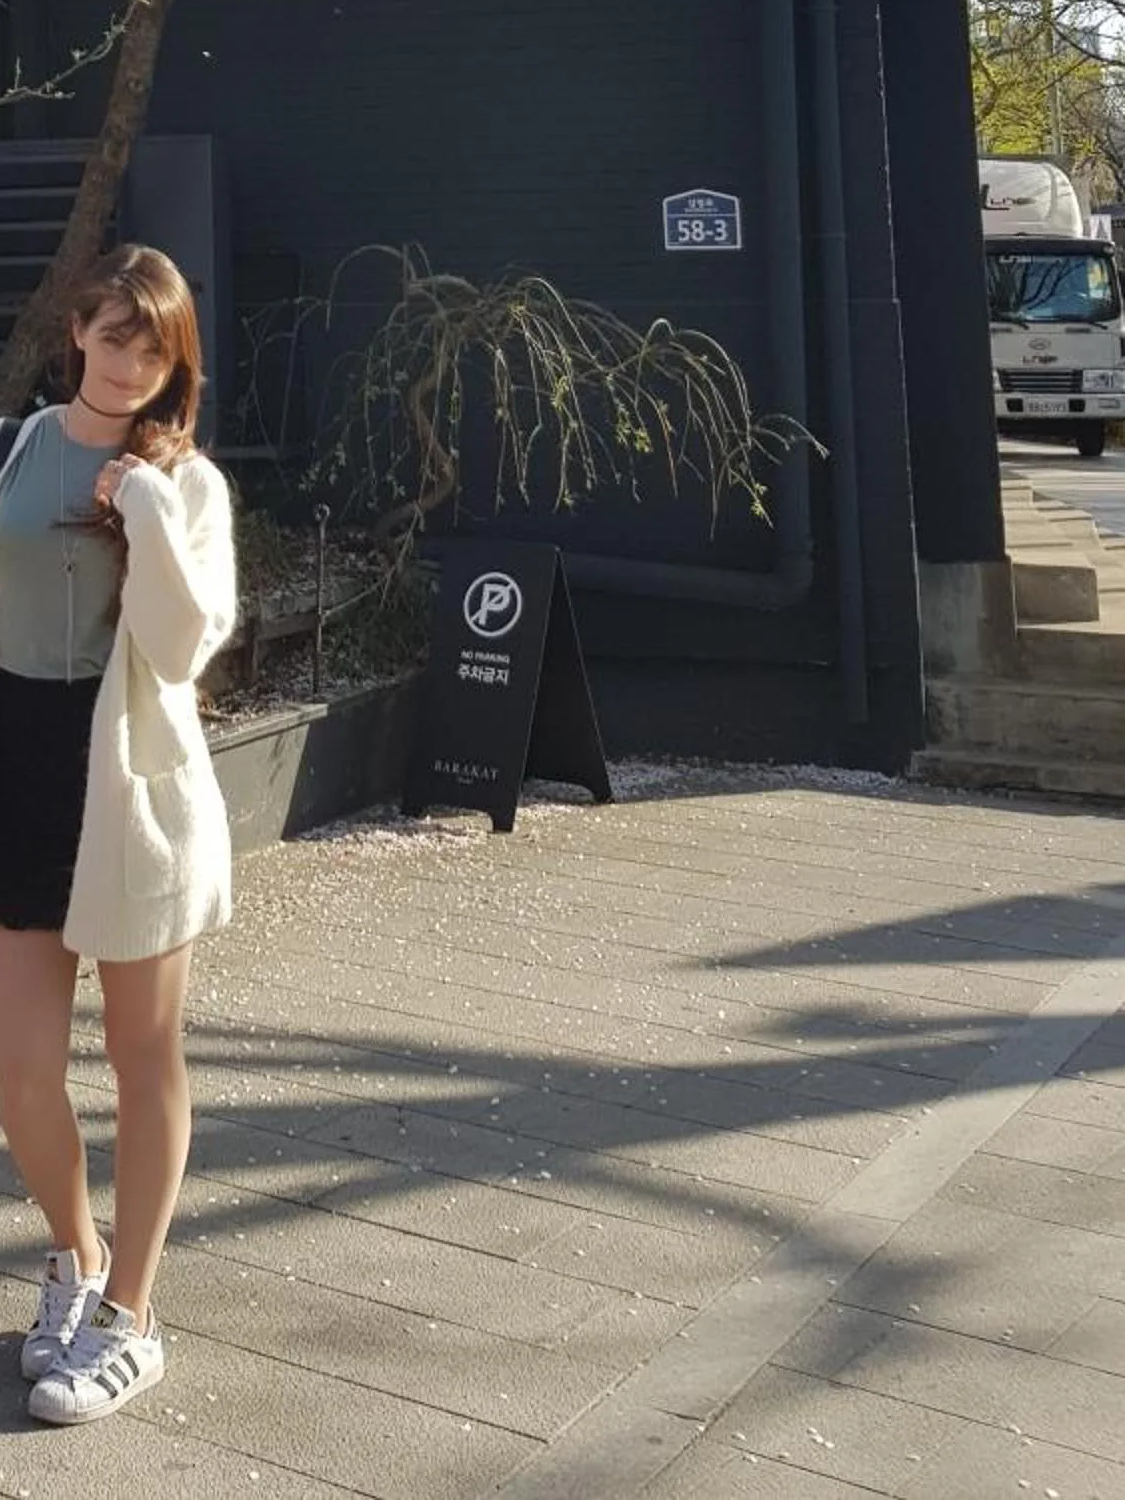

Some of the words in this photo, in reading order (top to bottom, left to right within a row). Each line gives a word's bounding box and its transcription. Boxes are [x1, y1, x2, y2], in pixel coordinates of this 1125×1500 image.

[678, 219, 727, 242] 58-3
[461, 650, 474, 660] NO
[475, 651, 510, 664] PARKING
[458, 663, 509, 685] 주차금지
